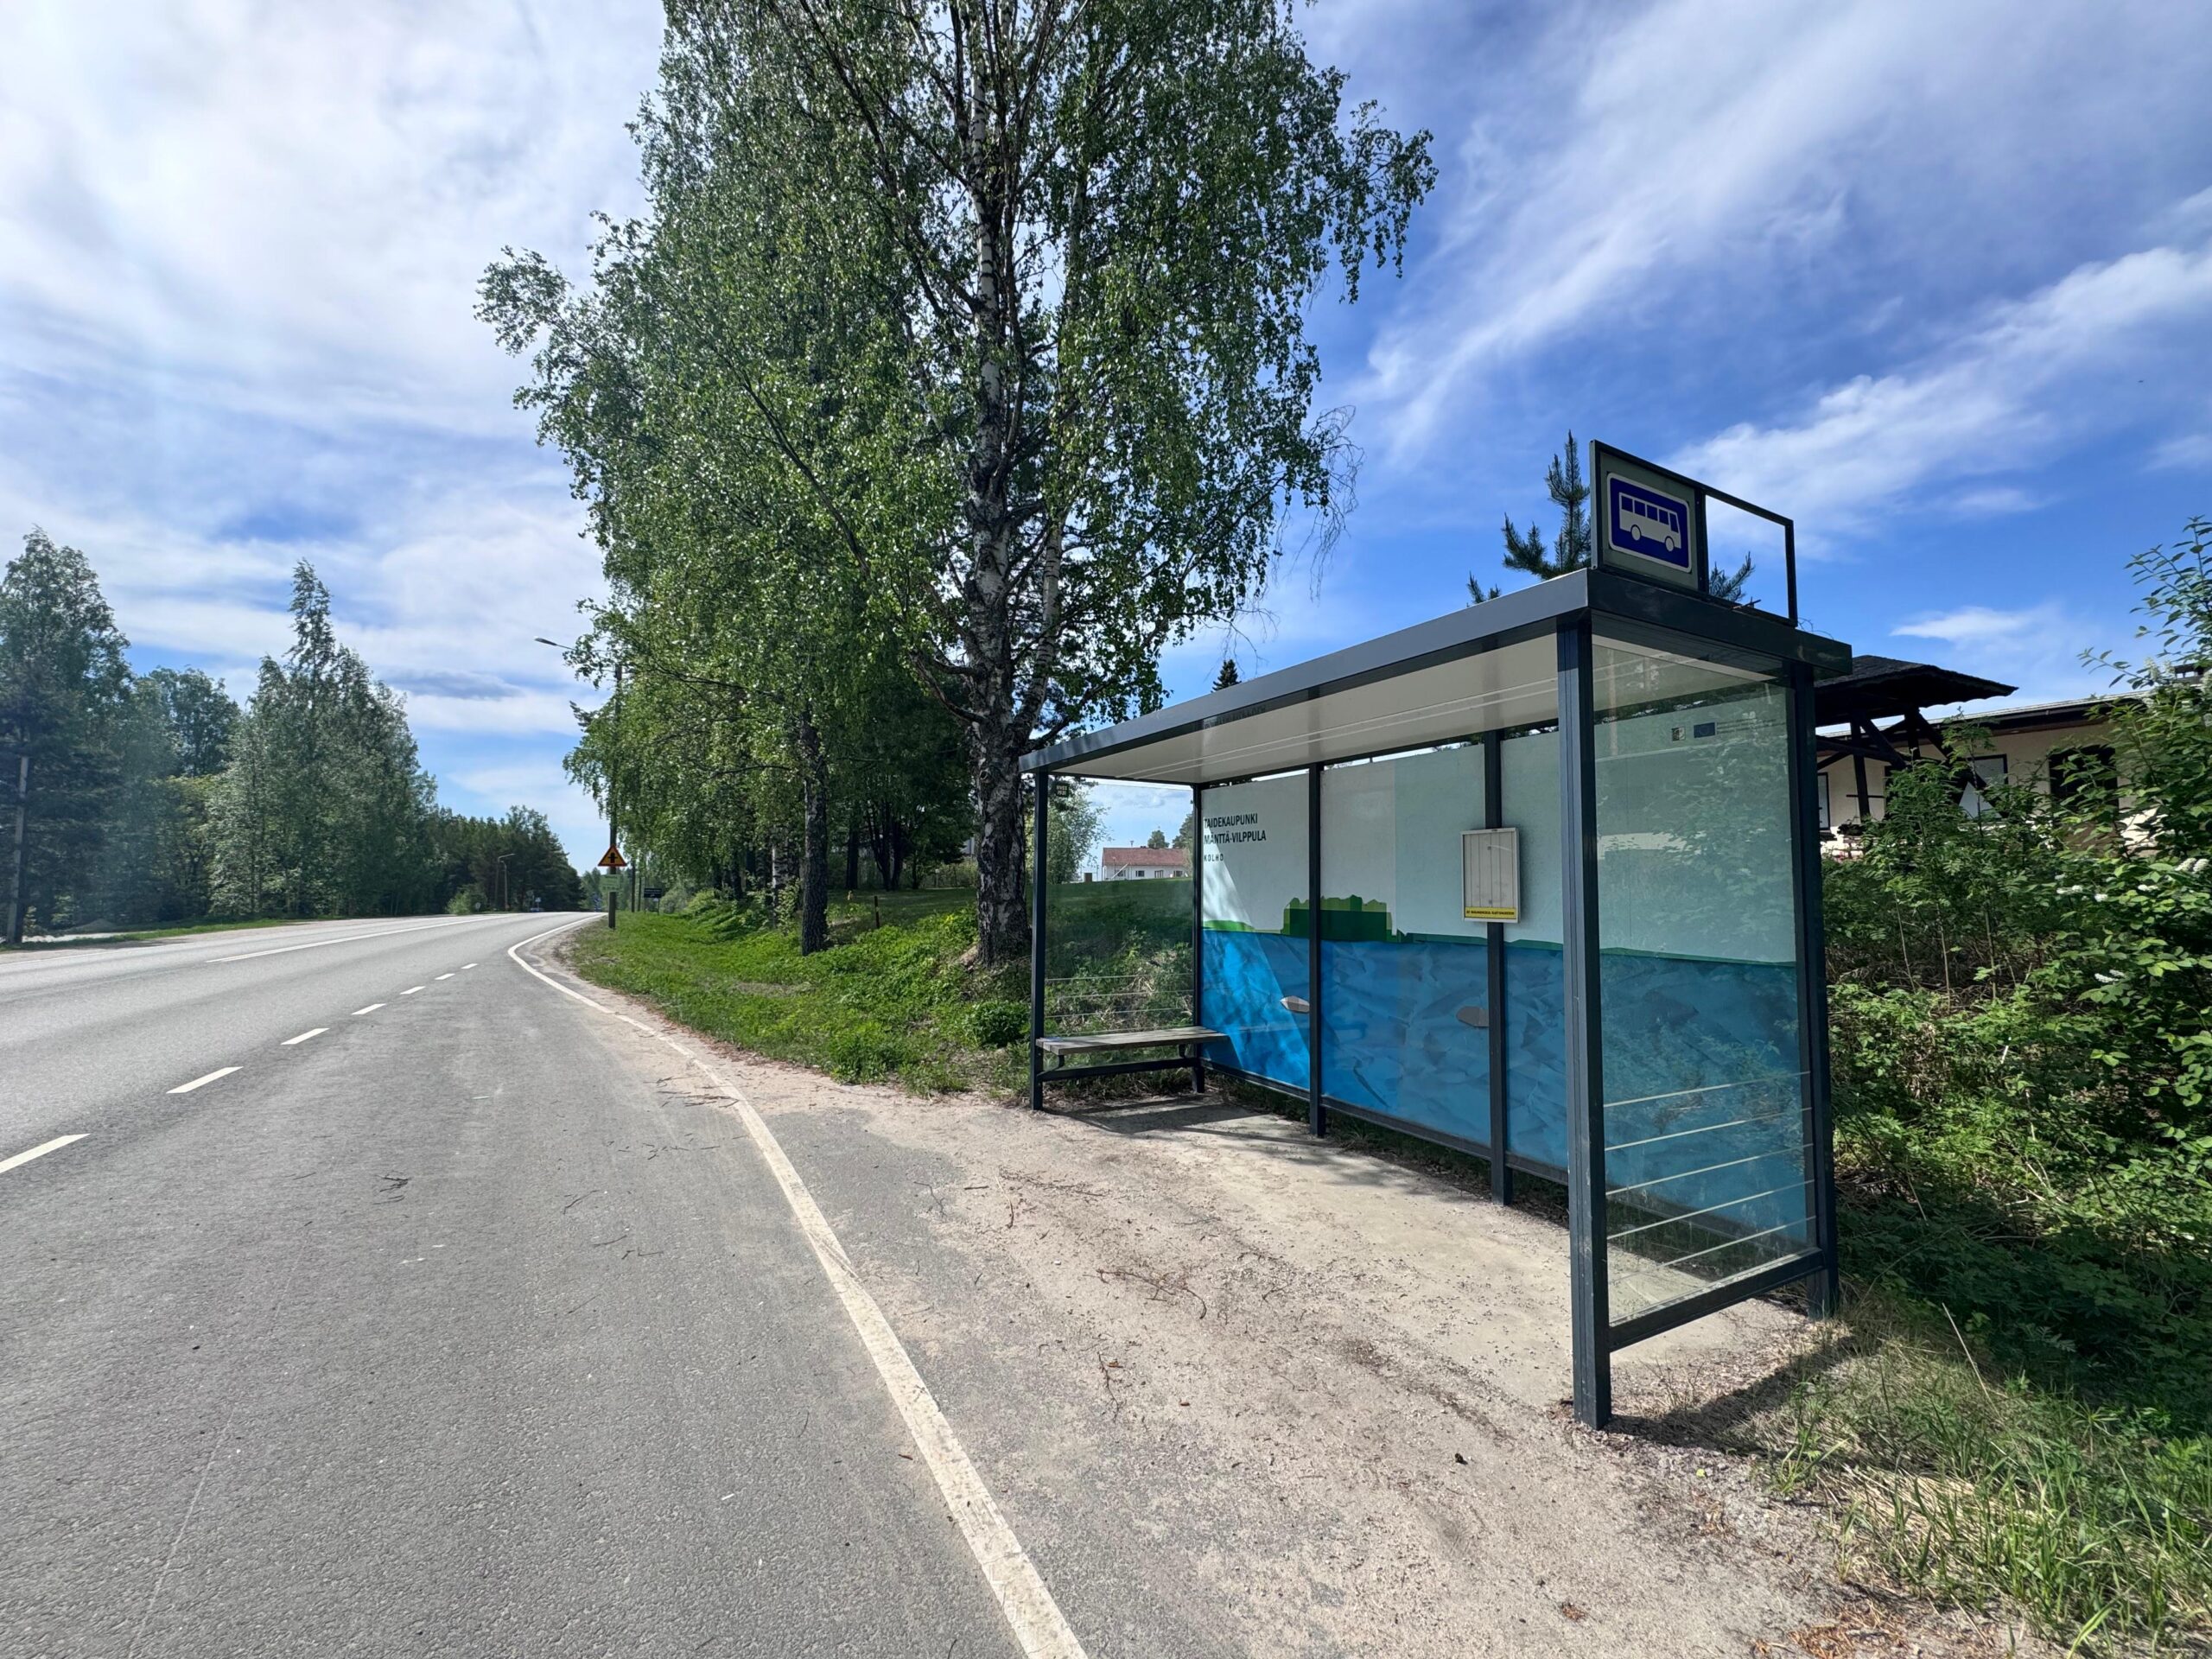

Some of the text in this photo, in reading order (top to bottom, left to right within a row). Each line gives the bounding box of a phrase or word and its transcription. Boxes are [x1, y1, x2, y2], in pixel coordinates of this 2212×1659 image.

[1204, 813, 1258, 829] TAIDEKAUPUNKI
[1204, 830, 1267, 844] MÄNTTÄ-VILPPULA
[1204, 853, 1224, 862] KOLHO
